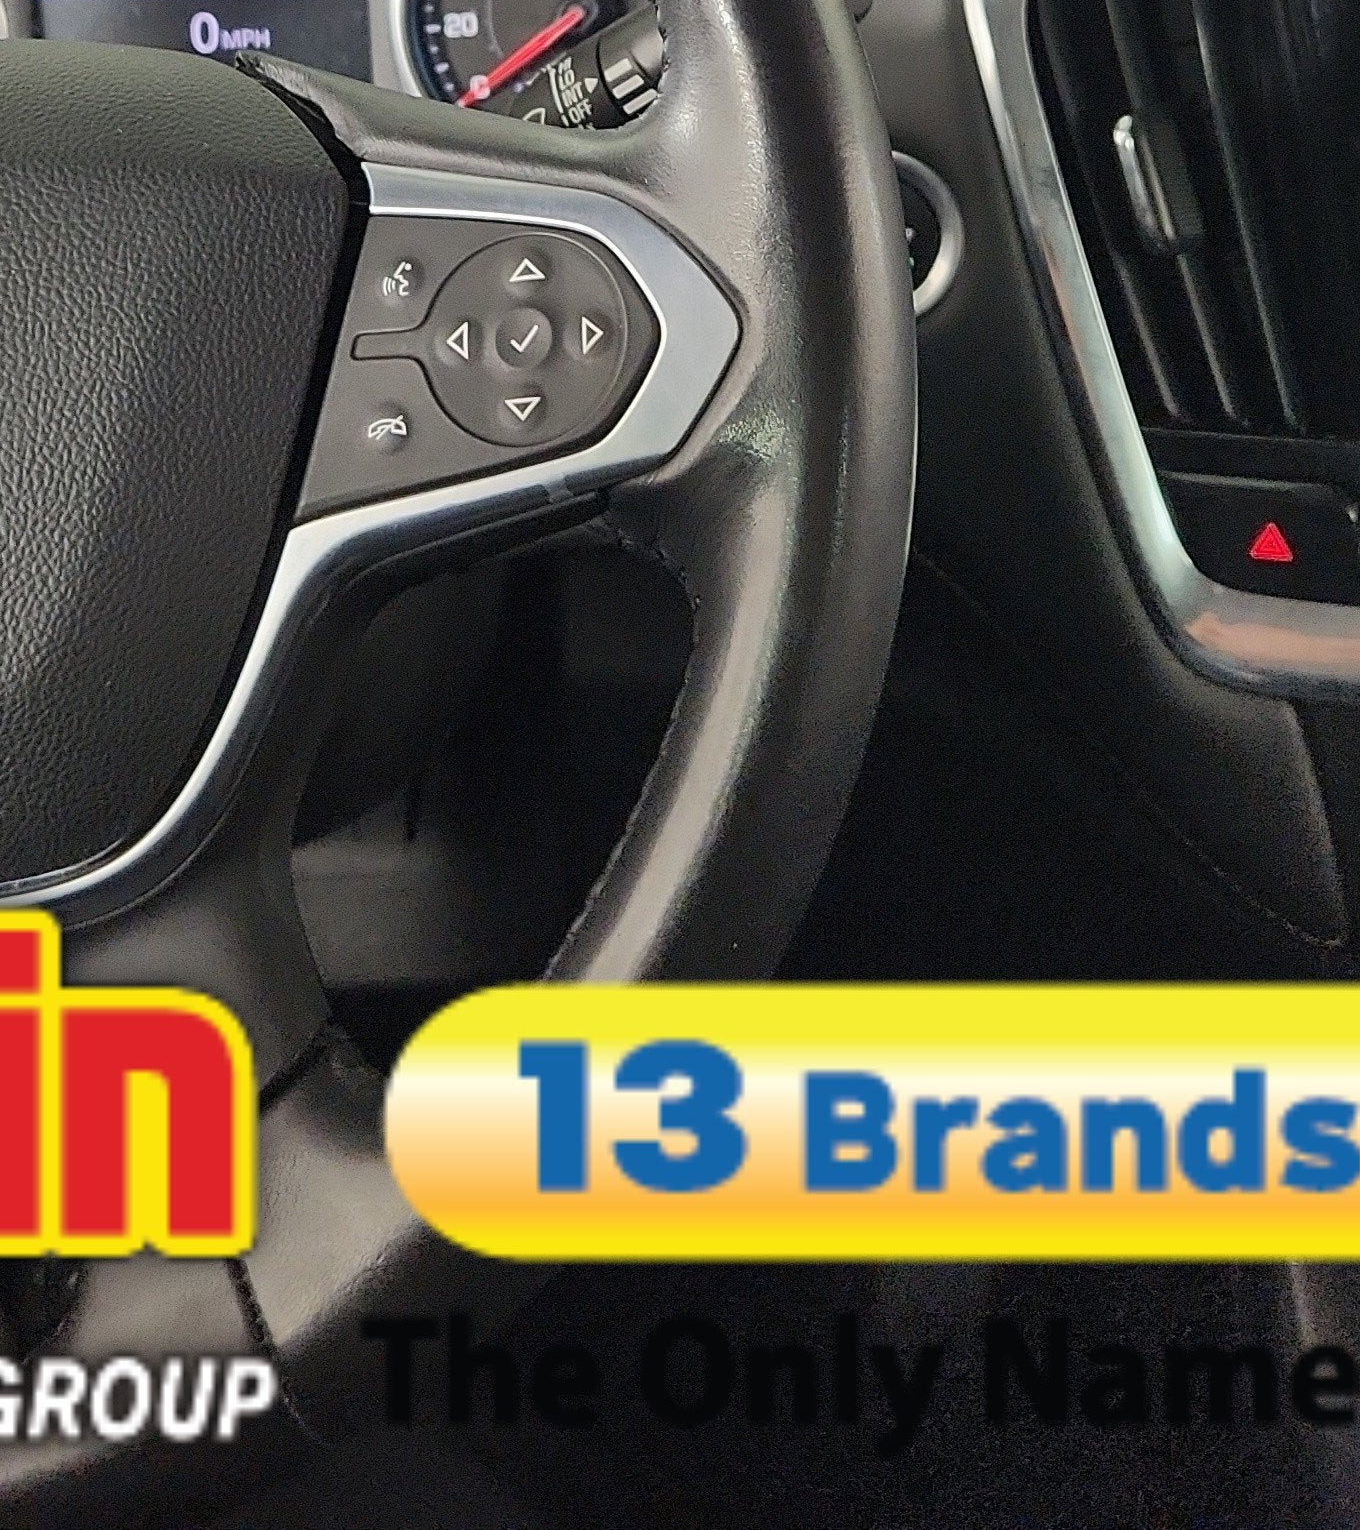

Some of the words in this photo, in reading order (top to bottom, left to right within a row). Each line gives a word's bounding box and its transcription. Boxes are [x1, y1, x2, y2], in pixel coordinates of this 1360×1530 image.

[443, 11, 479, 39] 20
[558, 69, 576, 91] LO
[561, 80, 585, 107] INT
[568, 97, 593, 125] OFF
